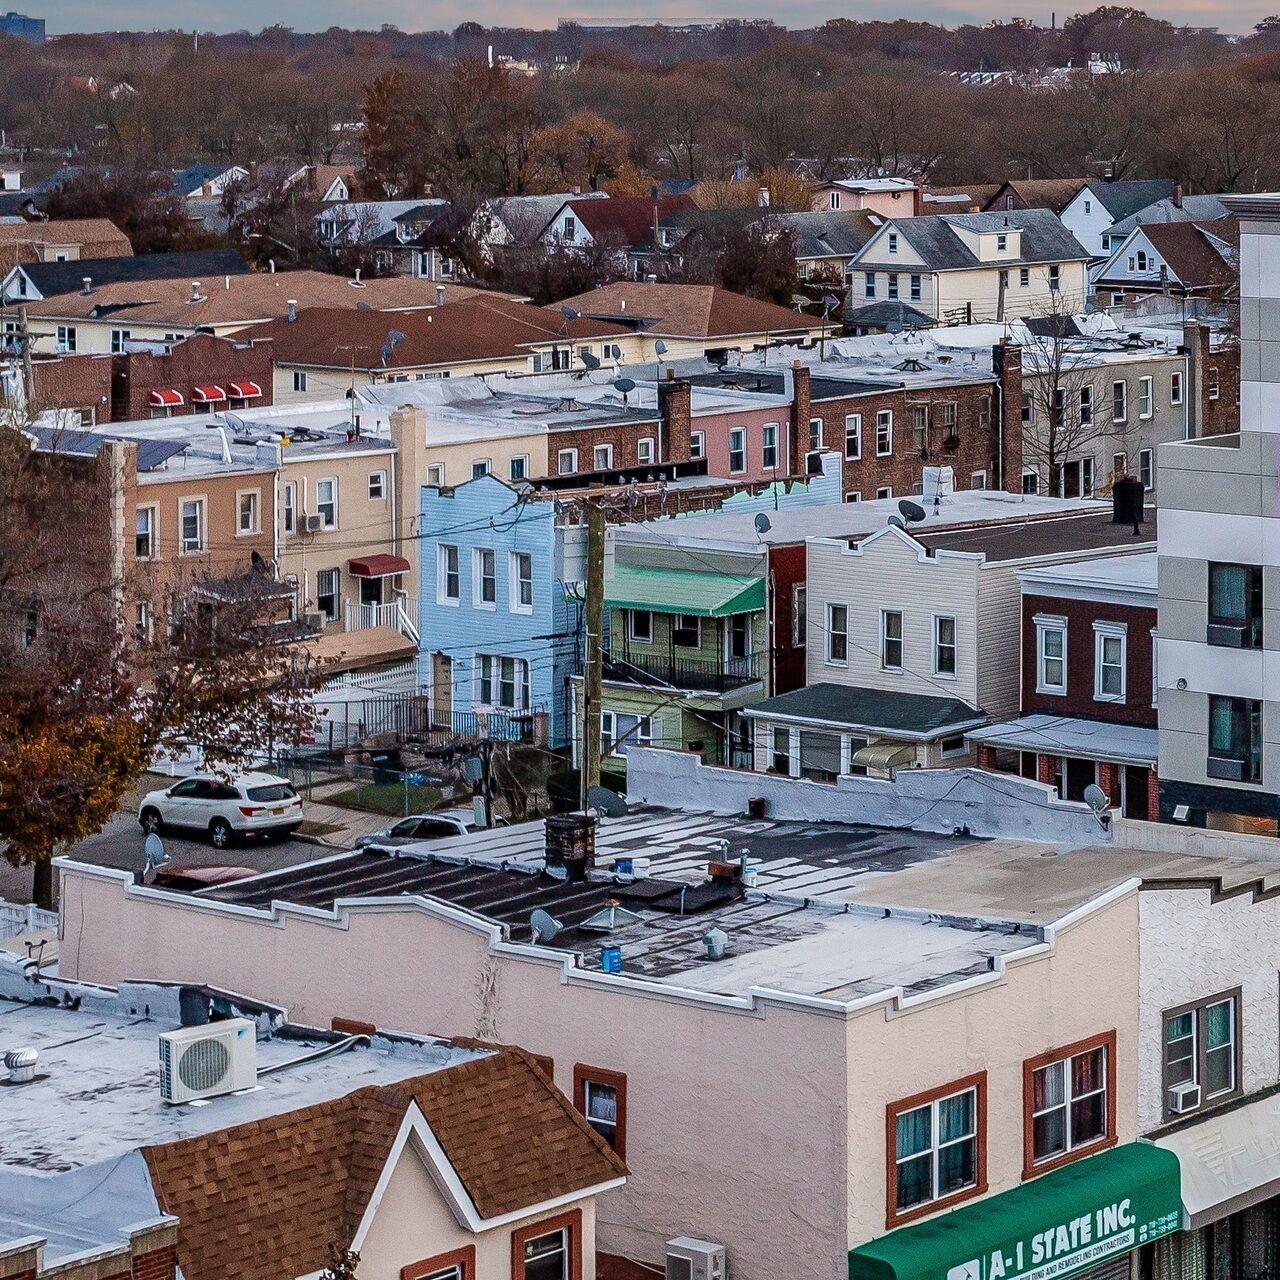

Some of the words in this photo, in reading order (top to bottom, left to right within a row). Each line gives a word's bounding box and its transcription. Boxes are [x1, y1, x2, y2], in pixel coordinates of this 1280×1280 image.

[989, 1241, 1024, 1280] A-1
[1031, 1212, 1092, 1264] STATE
[1096, 1198, 1136, 1238] INC.
[1045, 1263, 1057, 1275] AND
[1058, 1249, 1092, 1271] REMODELING
[1092, 1232, 1130, 1258] CONTRACTORS
